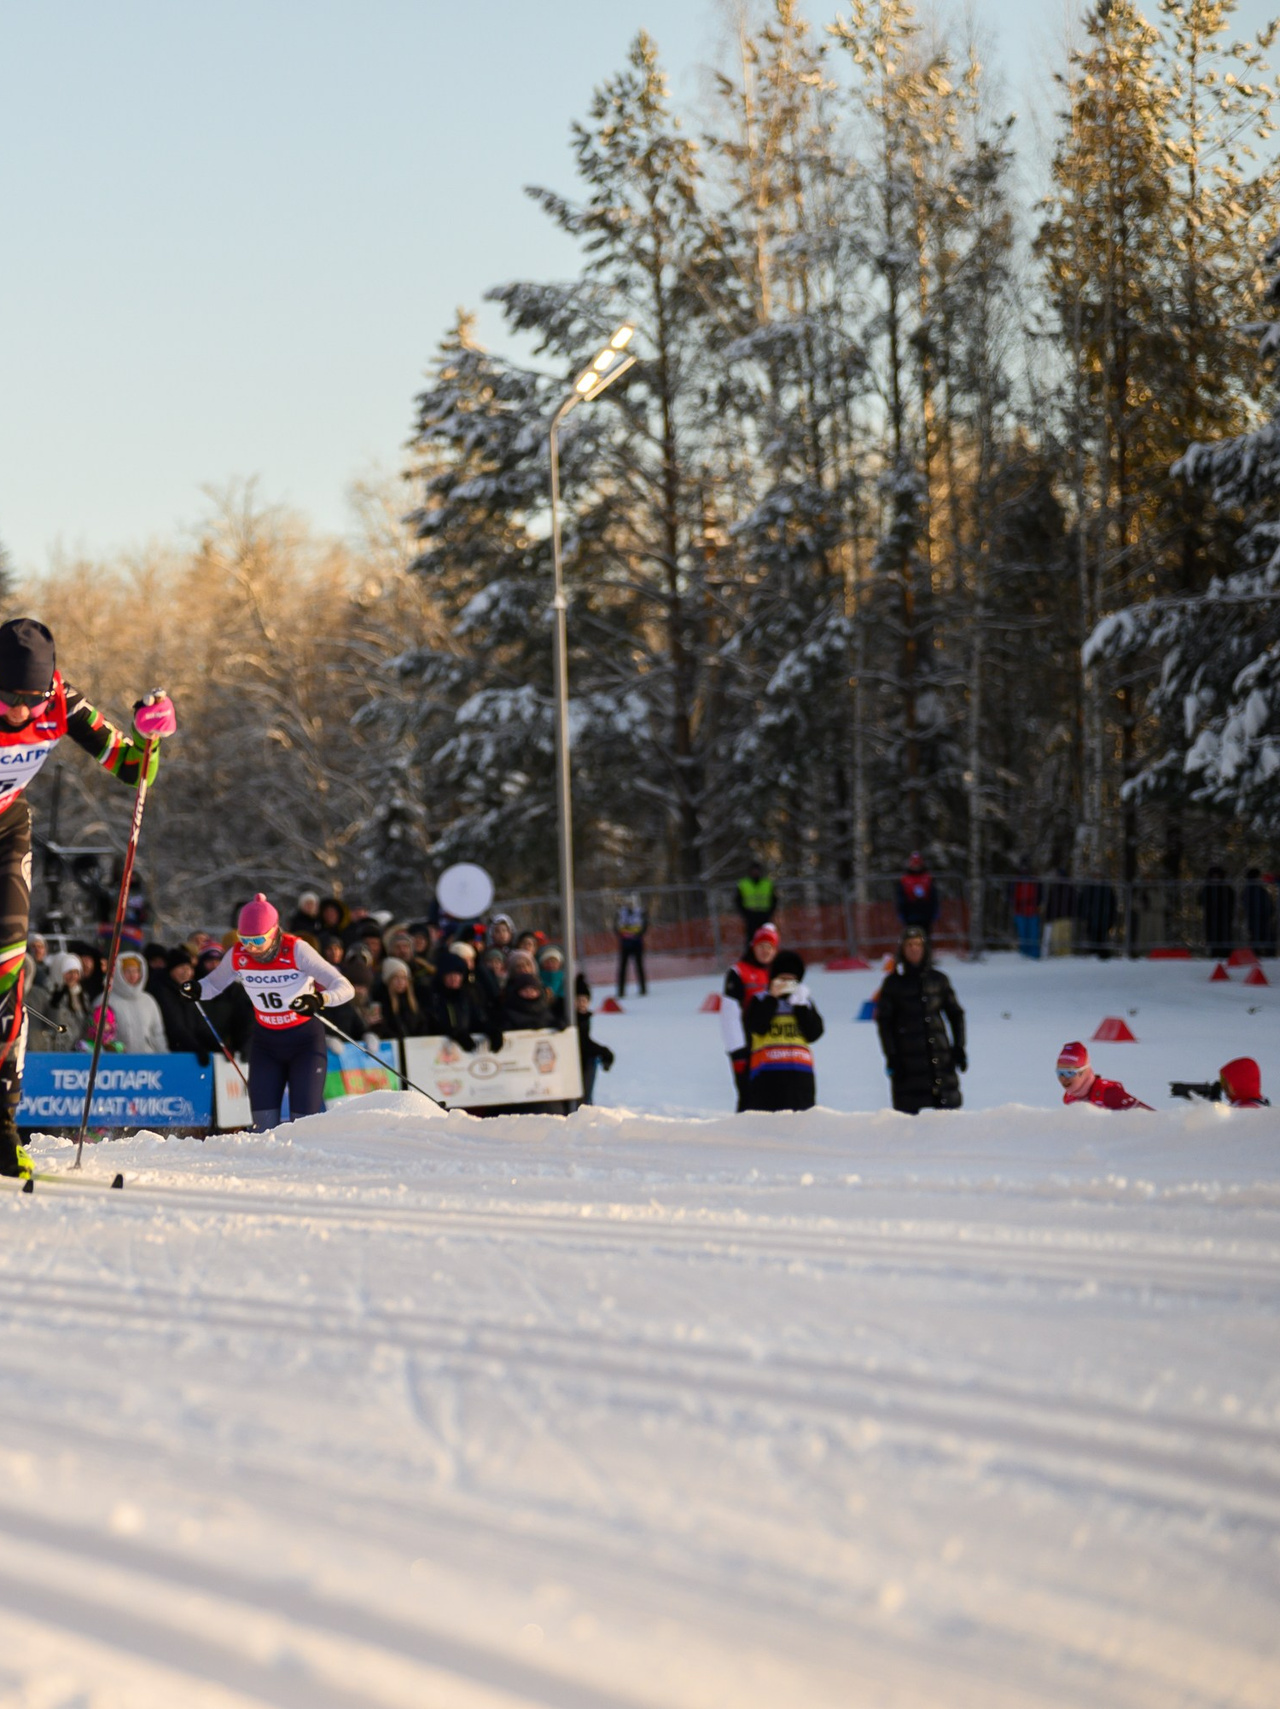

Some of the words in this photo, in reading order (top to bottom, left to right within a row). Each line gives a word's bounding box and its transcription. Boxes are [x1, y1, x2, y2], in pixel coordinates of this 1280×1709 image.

[245, 972, 299, 984] ФОСАГРО
[257, 991, 283, 1010] 16
[51, 1069, 163, 1091] ТЕХНОПАРК
